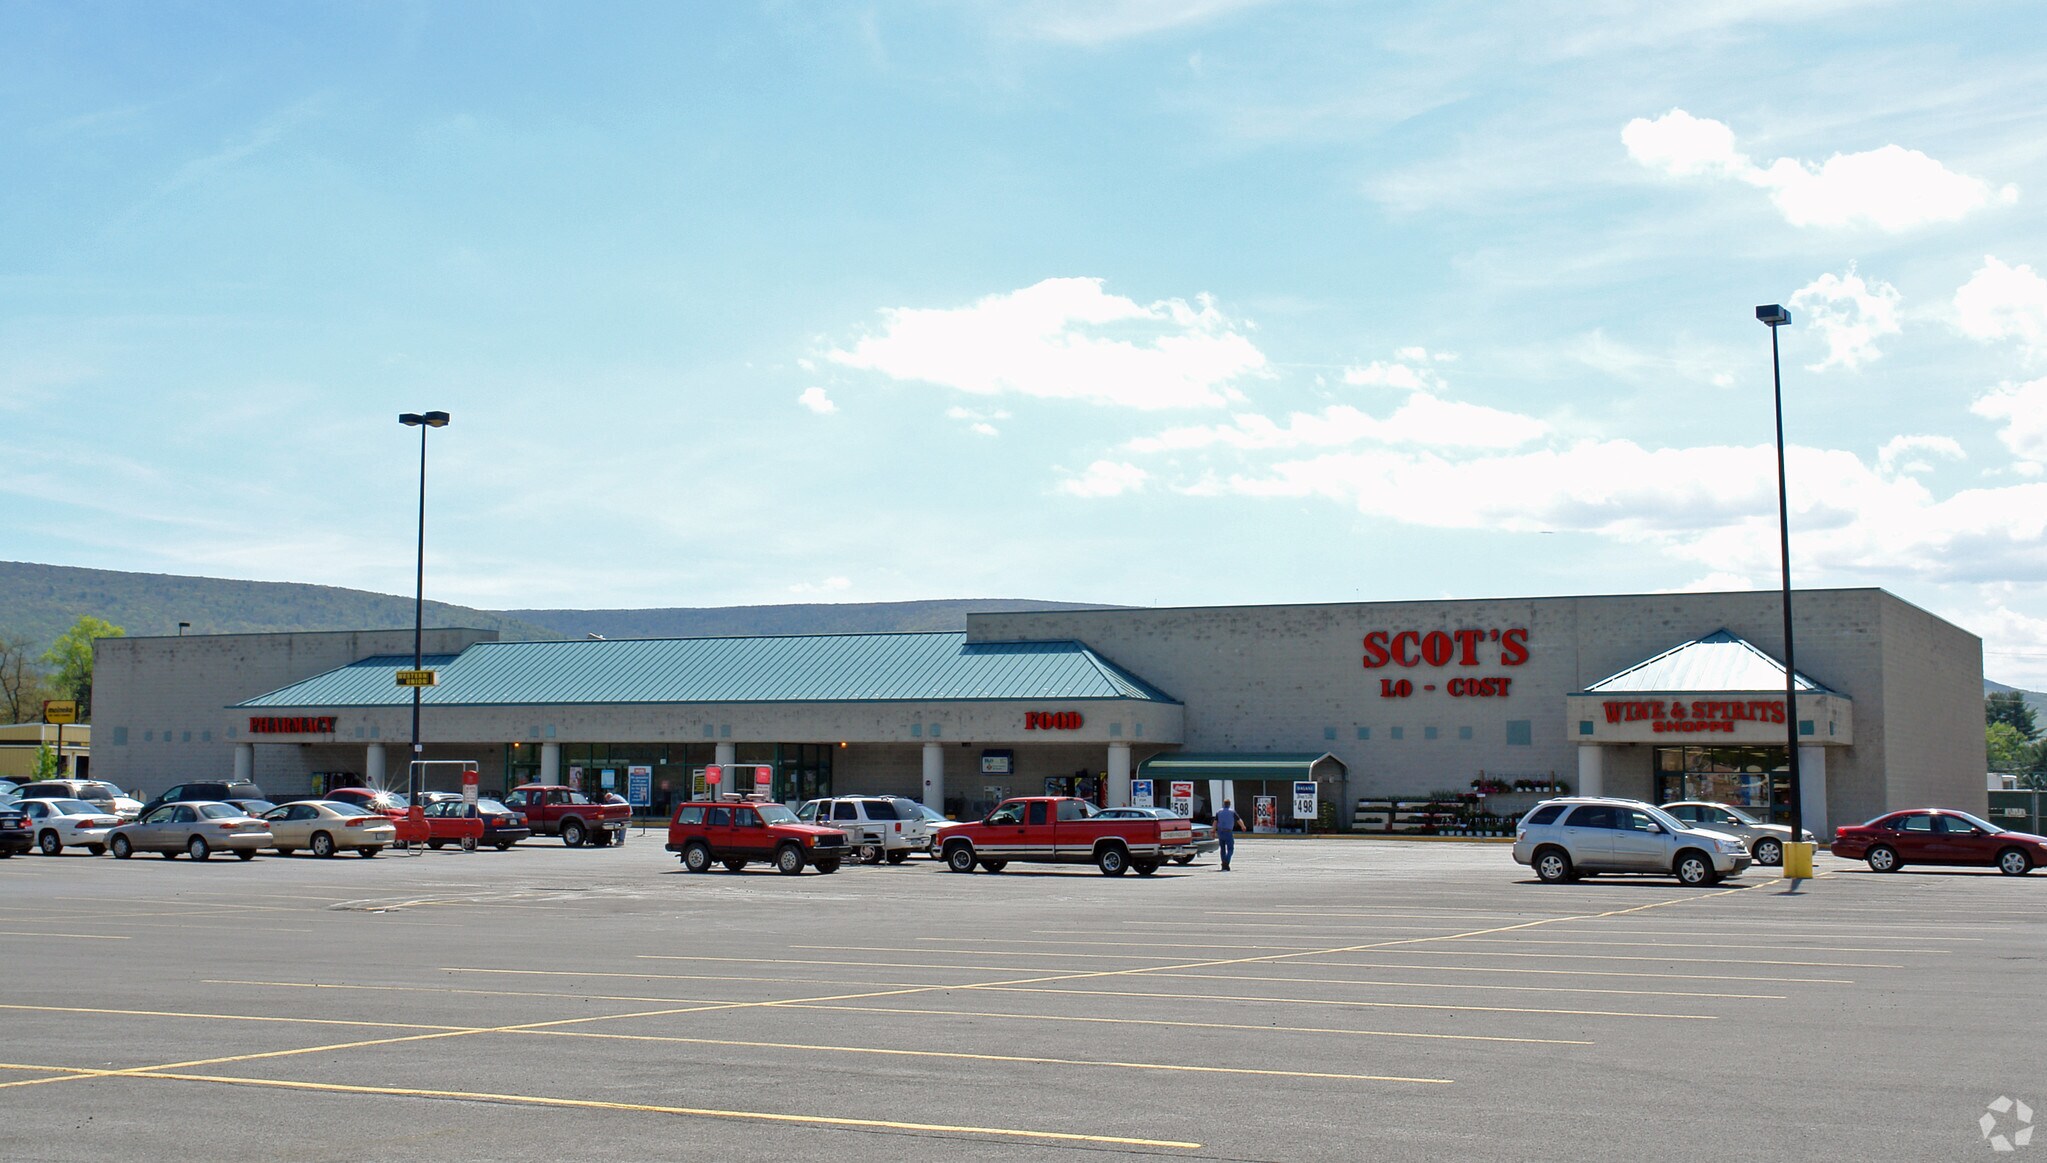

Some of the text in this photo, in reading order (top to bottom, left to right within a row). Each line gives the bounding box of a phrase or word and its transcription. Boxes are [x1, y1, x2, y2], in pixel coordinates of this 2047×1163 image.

[1363, 628, 1528, 668] SCOT'S
[1380, 678, 1412, 697] LO
[1447, 677, 1511, 697] COST
[1025, 711, 1084, 731] FOOD
[1603, 701, 1787, 724] WINE & SPIRITS
[248, 716, 338, 734] PHARMACY
[1651, 720, 1735, 733] SHOPPE
